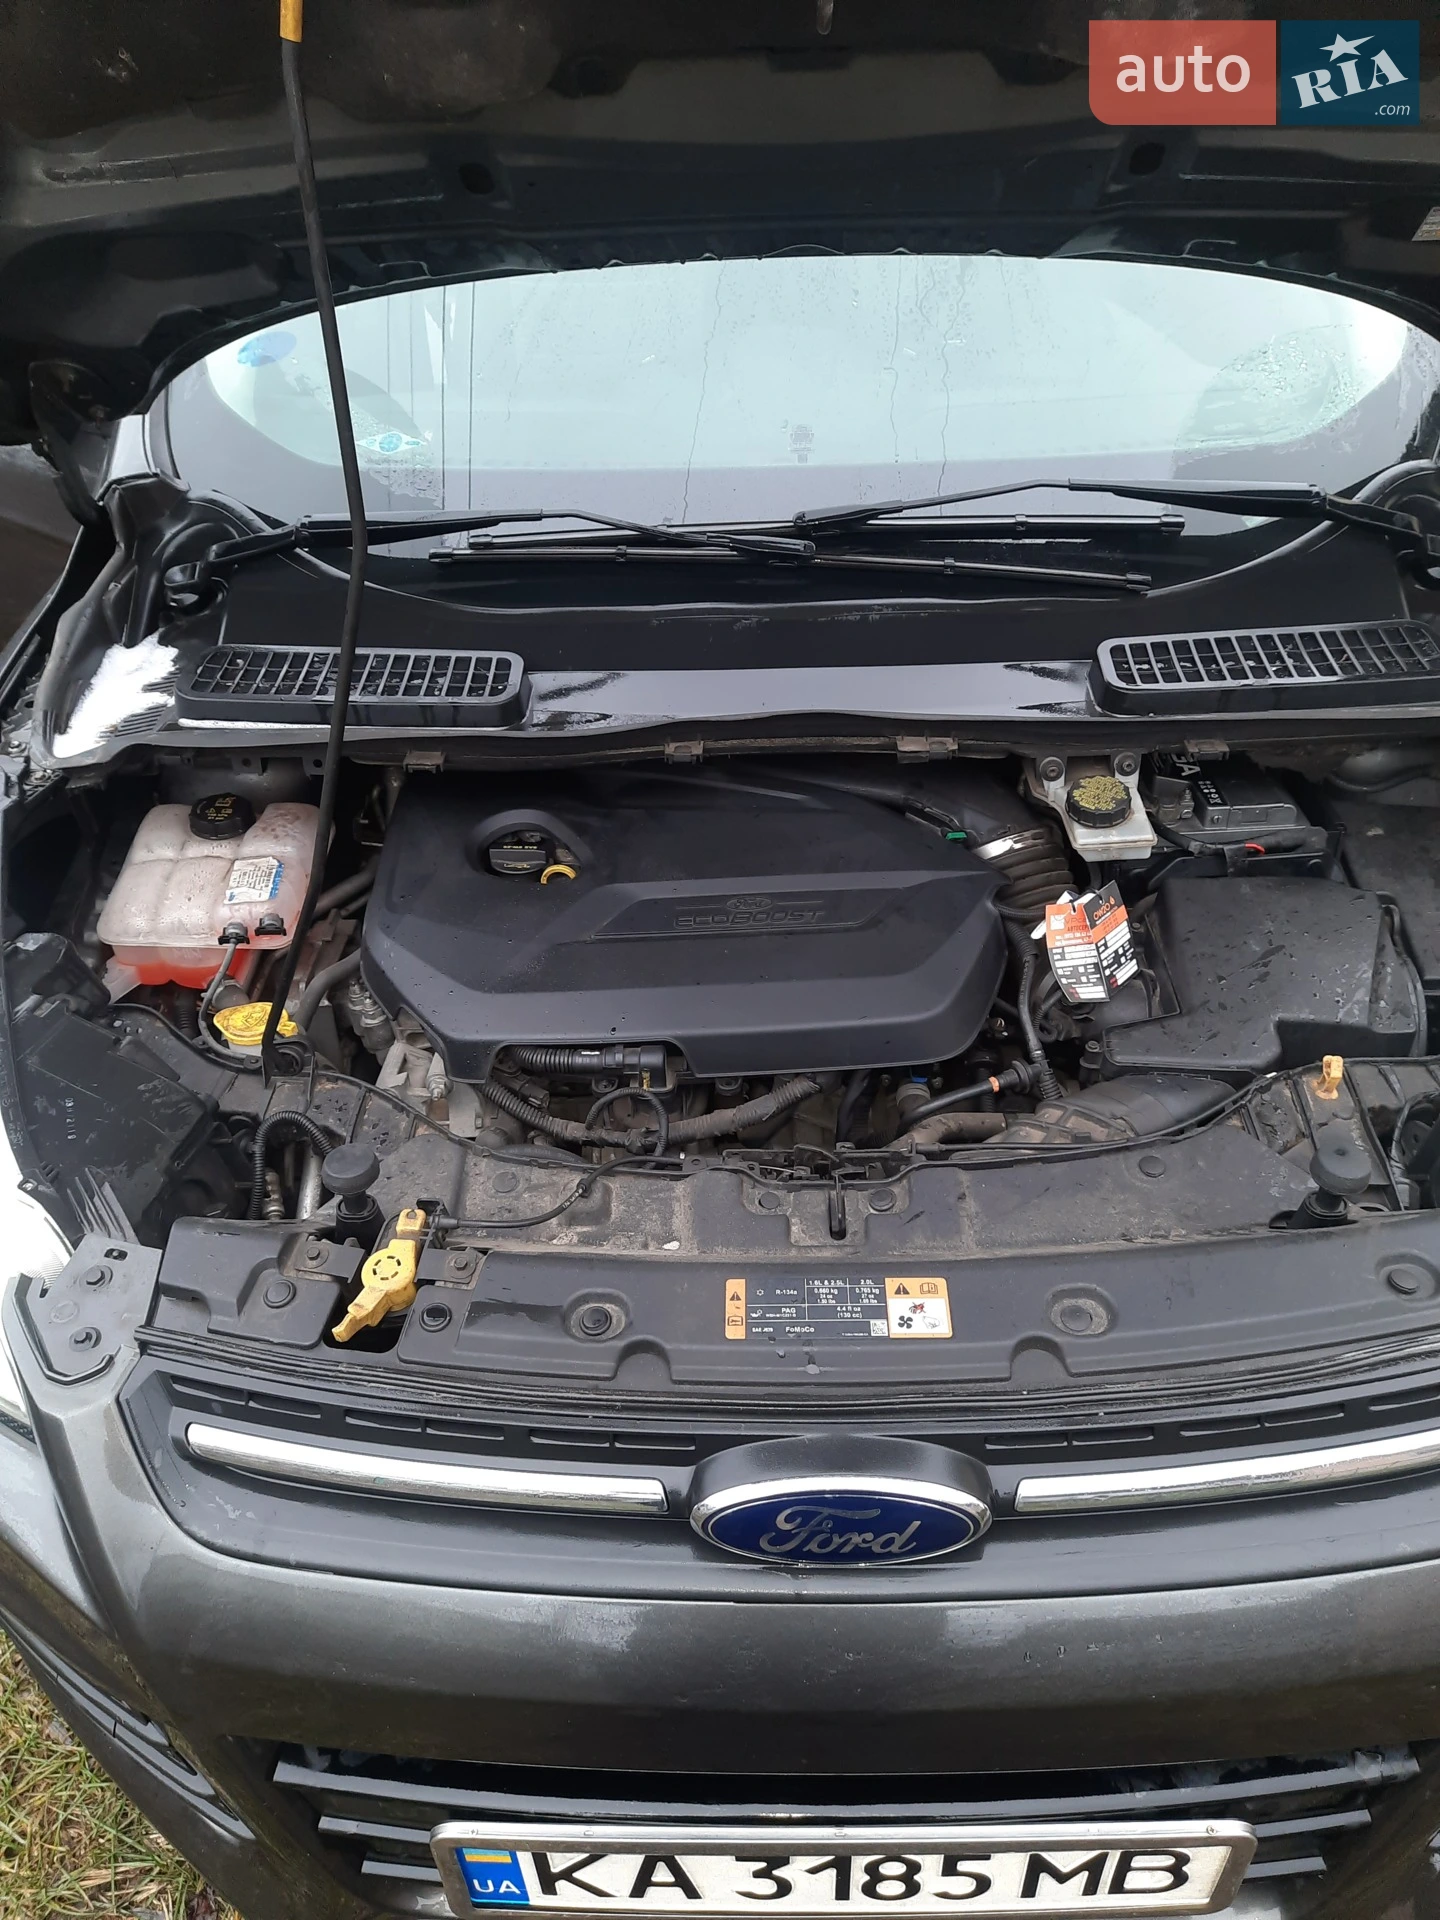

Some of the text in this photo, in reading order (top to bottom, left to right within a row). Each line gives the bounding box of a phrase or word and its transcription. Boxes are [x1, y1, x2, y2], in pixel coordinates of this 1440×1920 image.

[759, 1505, 922, 1555] Ford
[473, 1878, 522, 1895] UA
[531, 1849, 1191, 1900] KA 3185 MB
